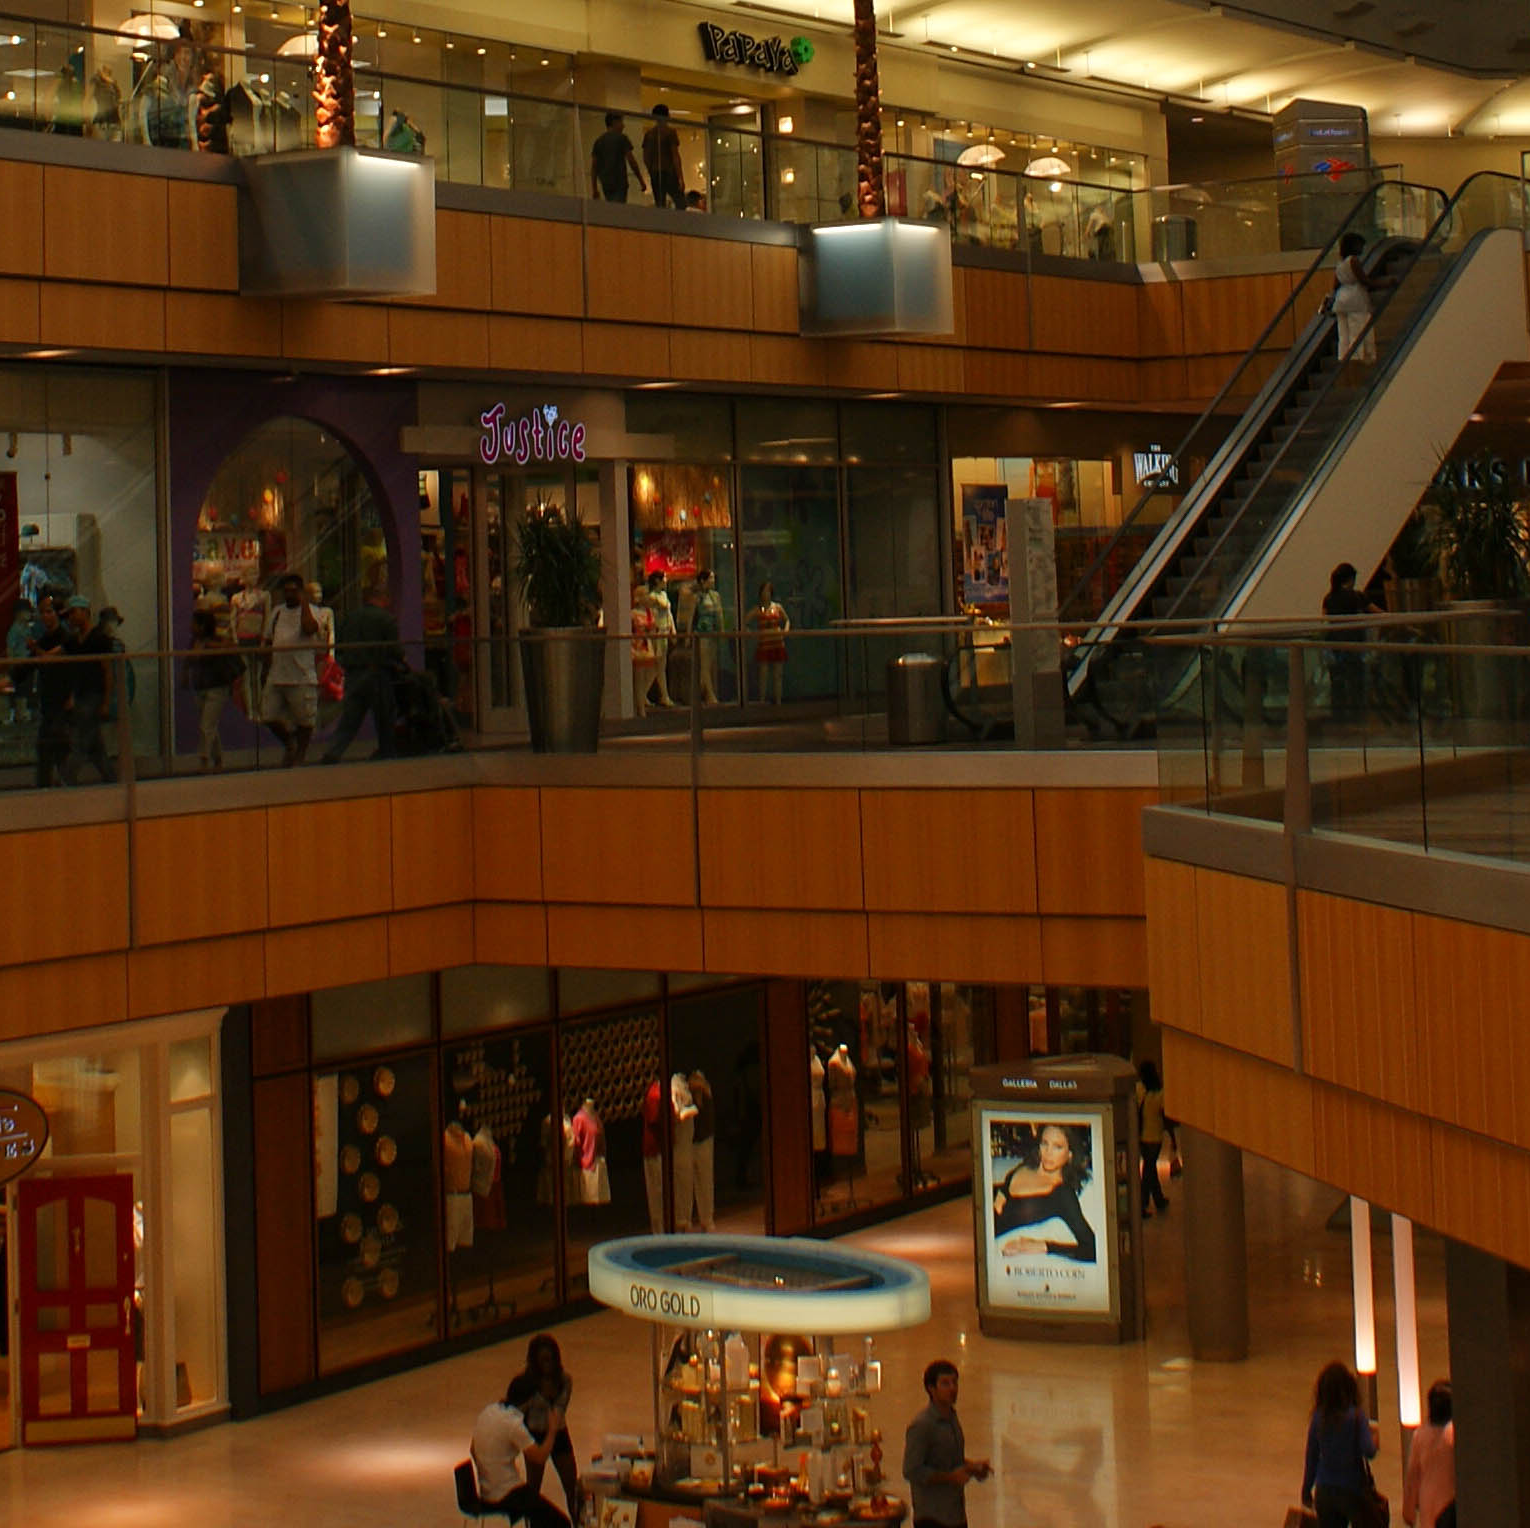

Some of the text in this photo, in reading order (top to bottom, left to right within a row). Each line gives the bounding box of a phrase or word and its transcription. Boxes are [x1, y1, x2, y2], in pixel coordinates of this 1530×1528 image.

[480, 402, 586, 464] Justice
[630, 1284, 701, 1318] ORO GOLD
